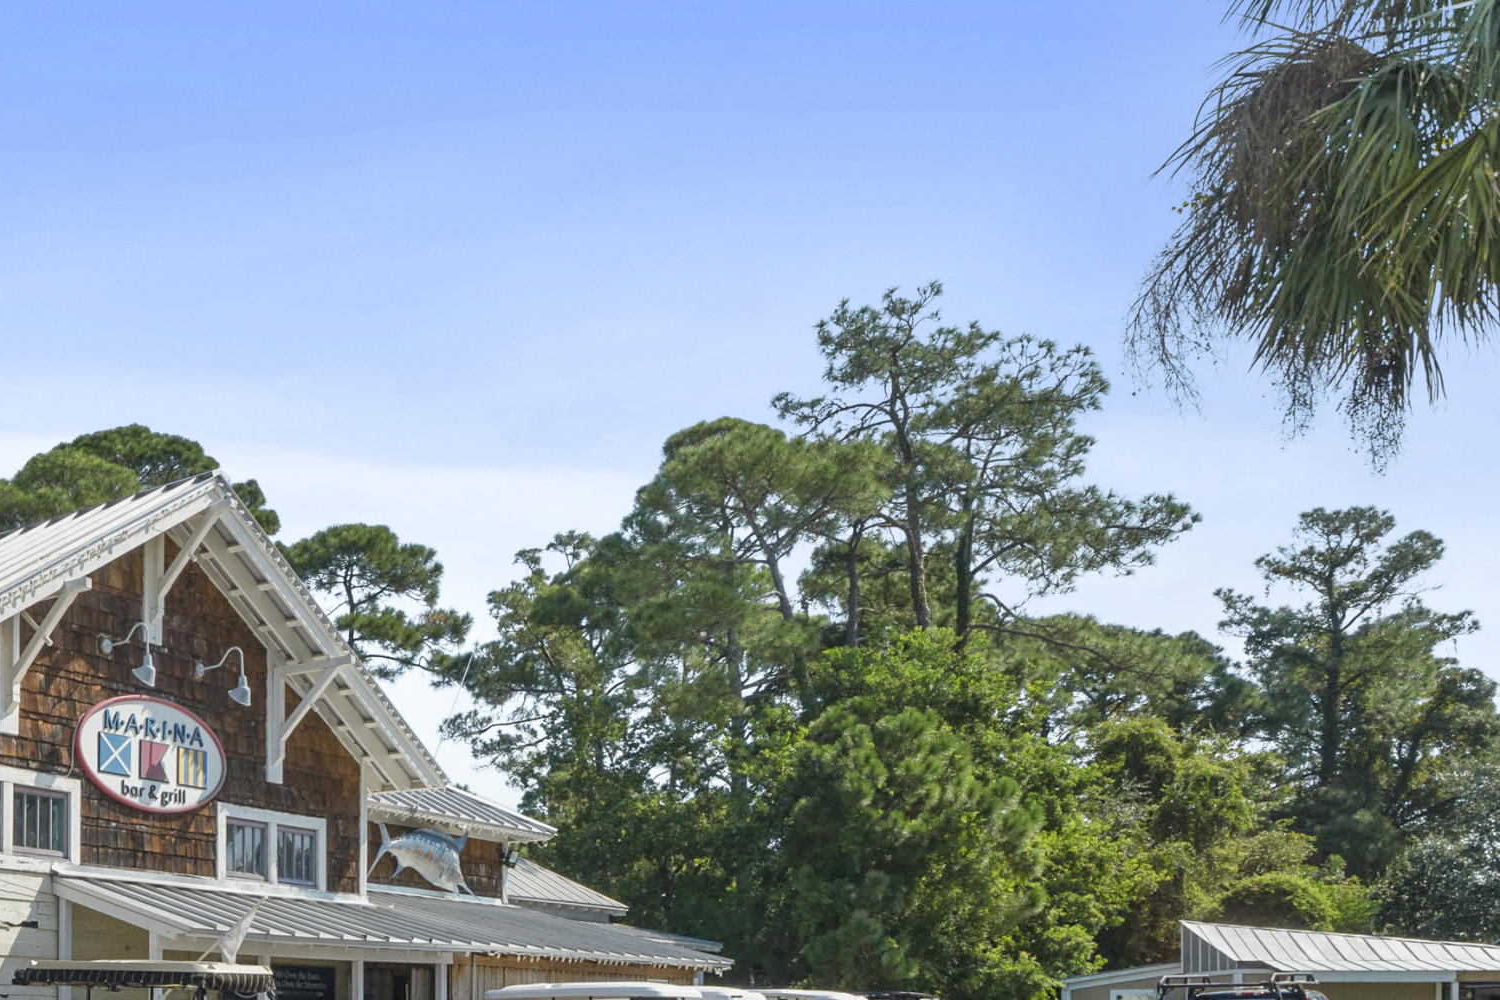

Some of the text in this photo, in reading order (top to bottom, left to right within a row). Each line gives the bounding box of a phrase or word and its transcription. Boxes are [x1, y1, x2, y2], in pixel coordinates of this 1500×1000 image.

[121, 780, 186, 807] bar & grill
